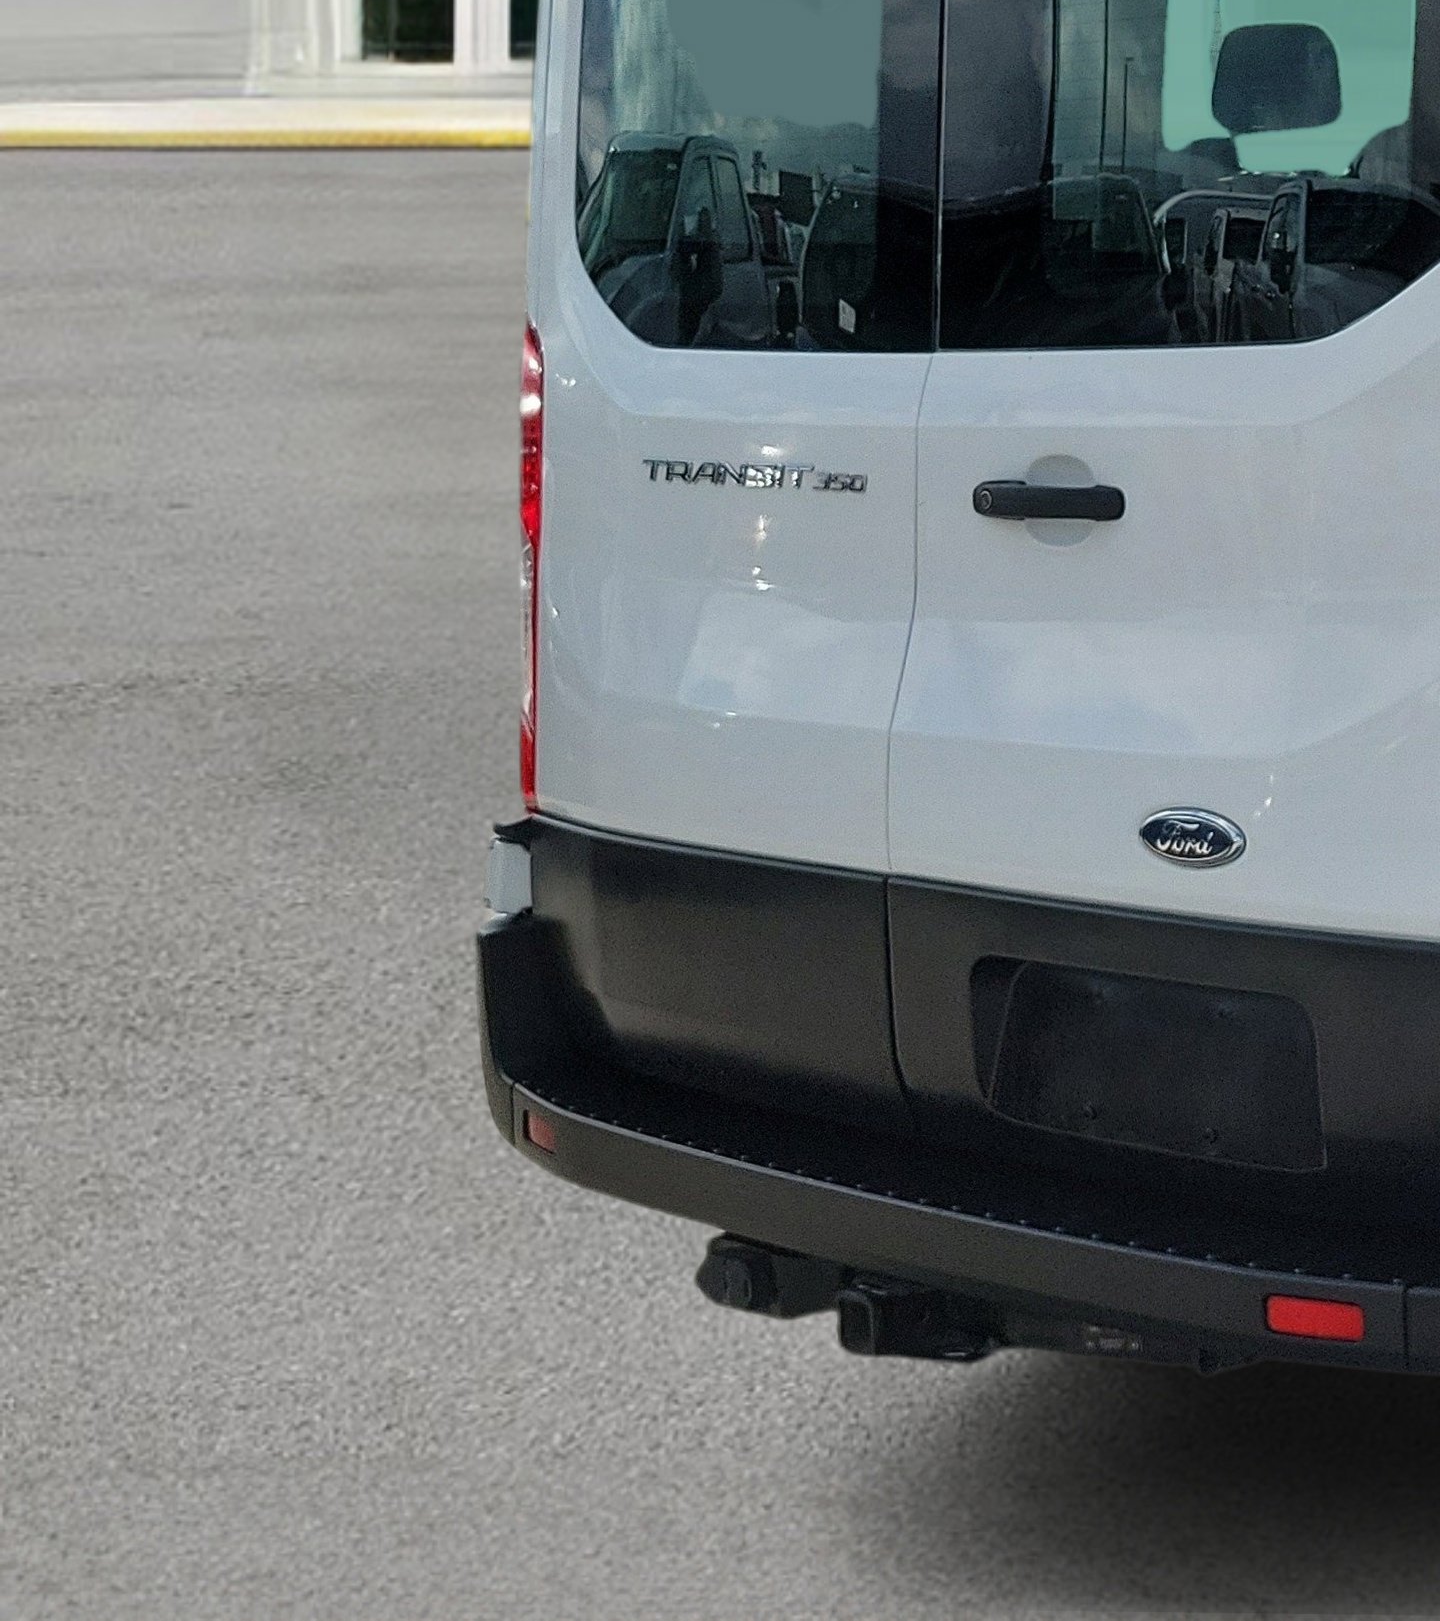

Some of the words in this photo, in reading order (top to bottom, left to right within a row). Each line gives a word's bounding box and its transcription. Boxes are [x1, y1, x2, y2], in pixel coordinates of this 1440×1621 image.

[642, 458, 815, 490] TRANSIT
[813, 471, 868, 494] 350
[1156, 820, 1214, 855] Ford
